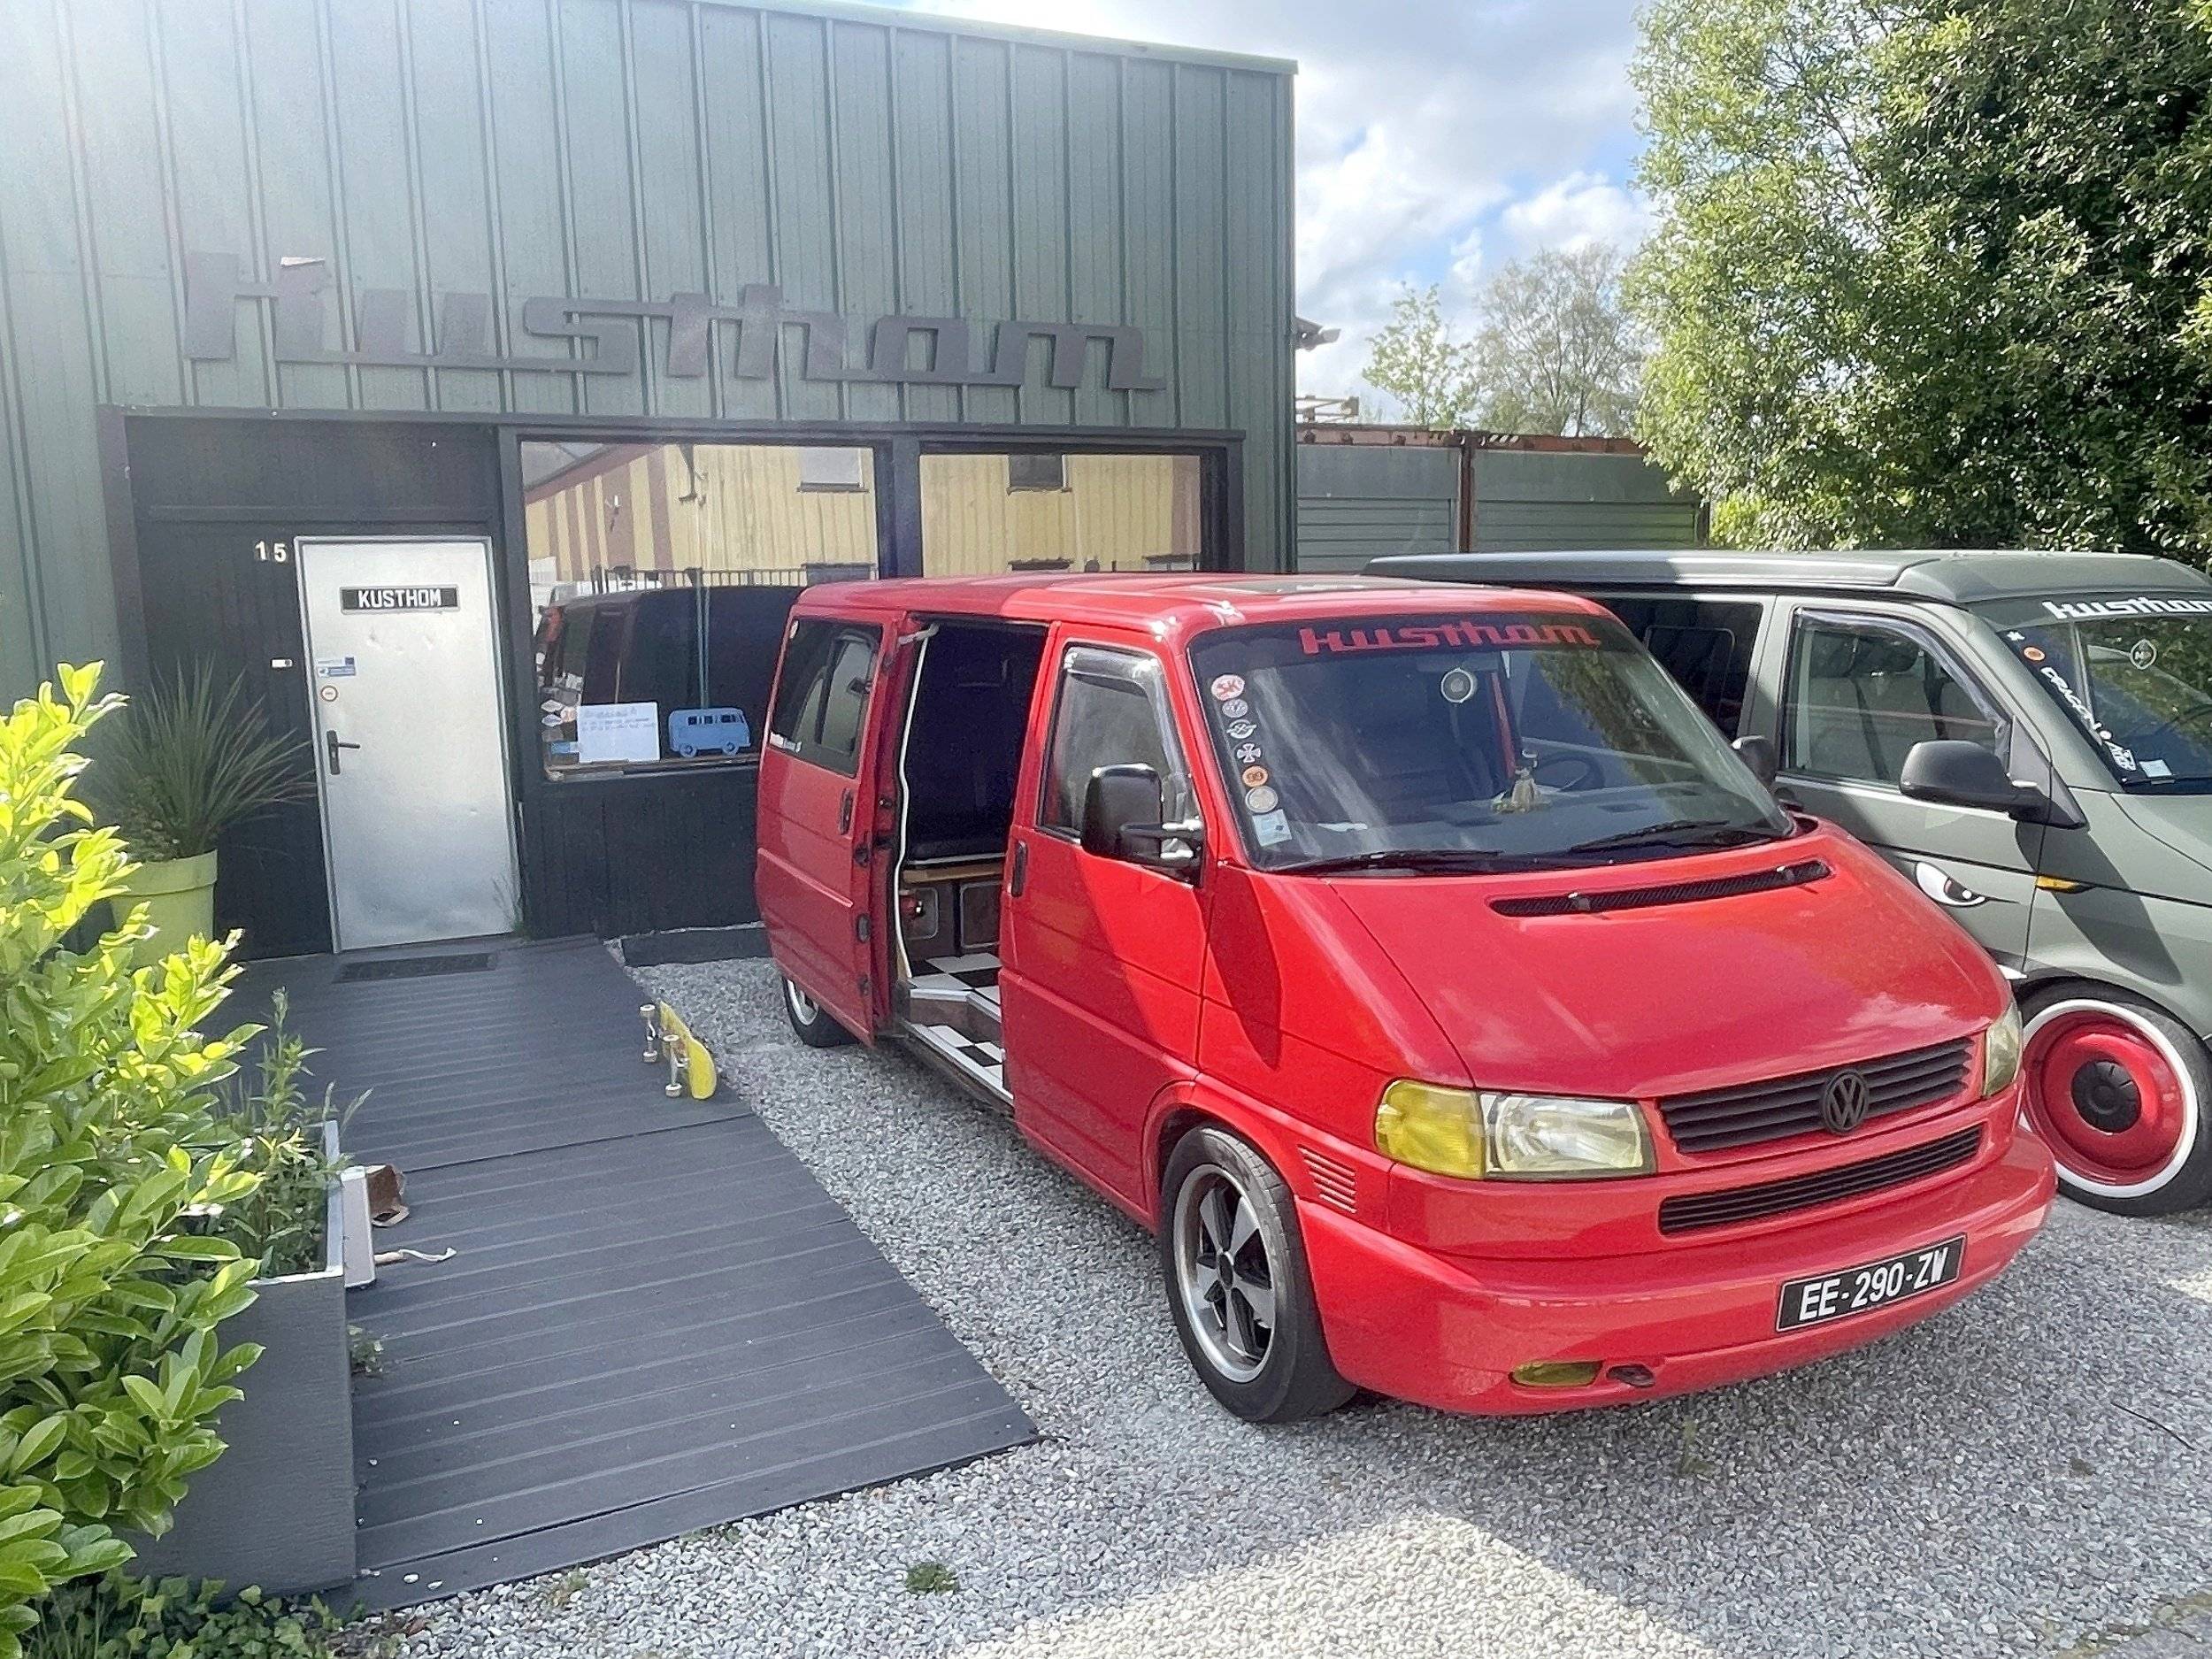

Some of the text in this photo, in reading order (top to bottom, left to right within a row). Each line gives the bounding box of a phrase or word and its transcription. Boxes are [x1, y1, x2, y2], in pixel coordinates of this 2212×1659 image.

[255, 541, 287, 563] 15
[357, 588, 442, 609] KUSTHOM
[1798, 1246, 1949, 1321] EE-290-ZW
